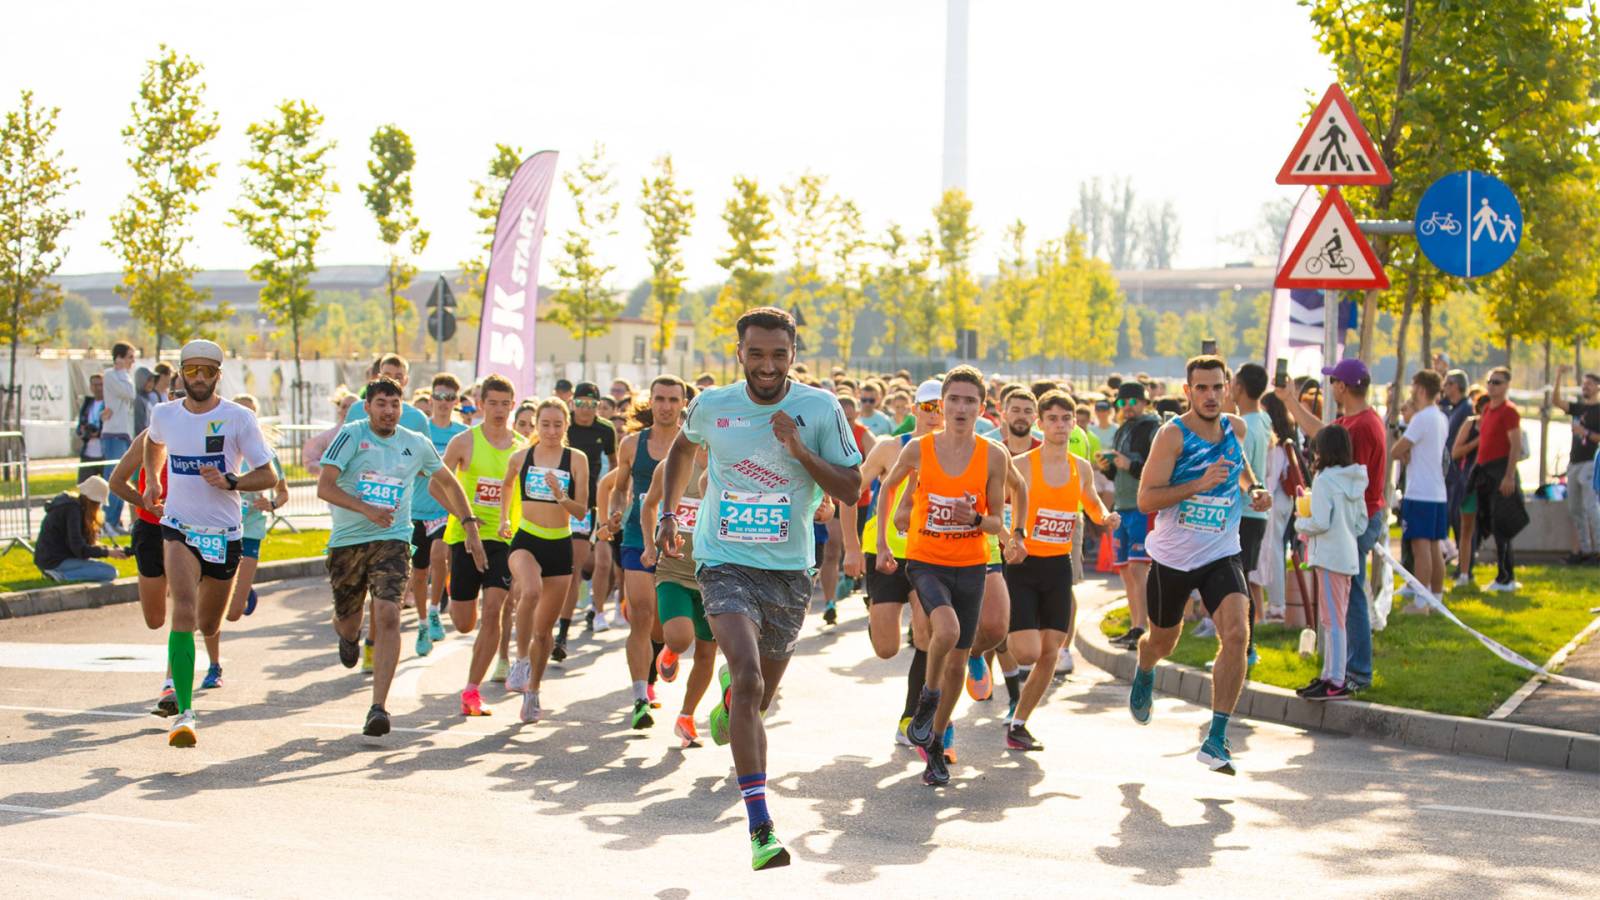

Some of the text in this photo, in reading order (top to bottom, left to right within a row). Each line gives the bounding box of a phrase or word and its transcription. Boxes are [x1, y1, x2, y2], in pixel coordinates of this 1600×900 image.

[489, 206, 537, 371] 5K START
[731, 463, 776, 489] FESTIVAL
[740, 459, 789, 485] RUNNING
[362, 483, 398, 500] 2481
[480, 485, 502, 498] 202
[726, 505, 784, 525] 2455
[931, 505, 952, 520] 20
[1185, 505, 1226, 521] 2570
[918, 529, 941, 538] RO
[1039, 518, 1072, 533] 2020
[191, 532, 222, 550] 499
